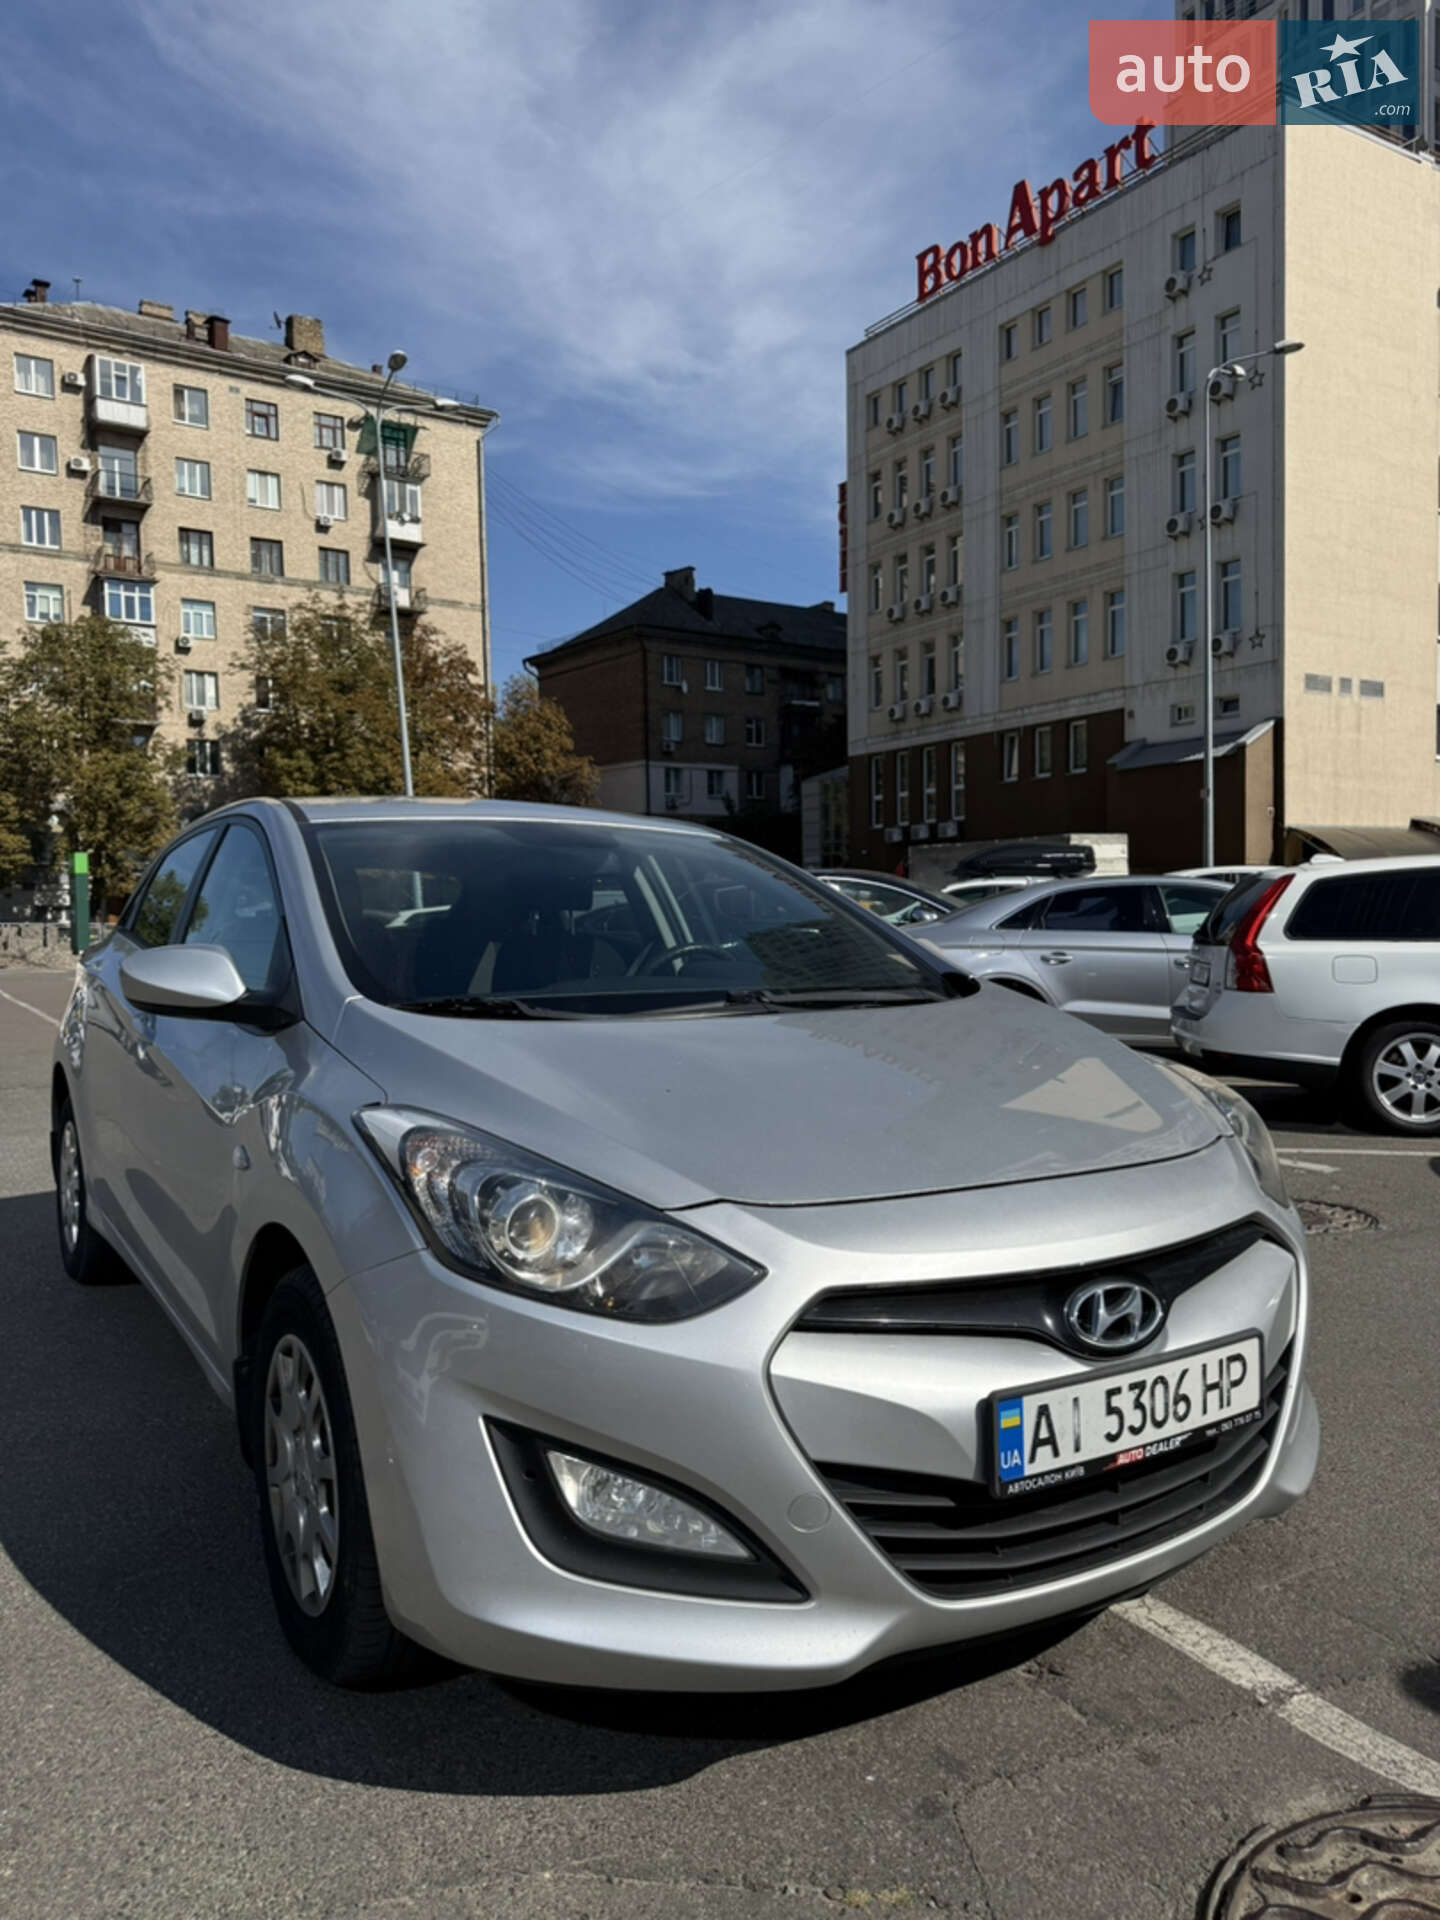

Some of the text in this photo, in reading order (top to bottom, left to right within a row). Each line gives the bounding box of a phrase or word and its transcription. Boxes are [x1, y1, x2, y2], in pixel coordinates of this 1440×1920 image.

[1028, 1397, 1081, 1464] AI
[1104, 1368, 1192, 1443] 5306
[1201, 1353, 1248, 1415] HP
[1001, 1449, 1022, 1469] UA
[1115, 1436, 1182, 1465] AUTO DEALER
